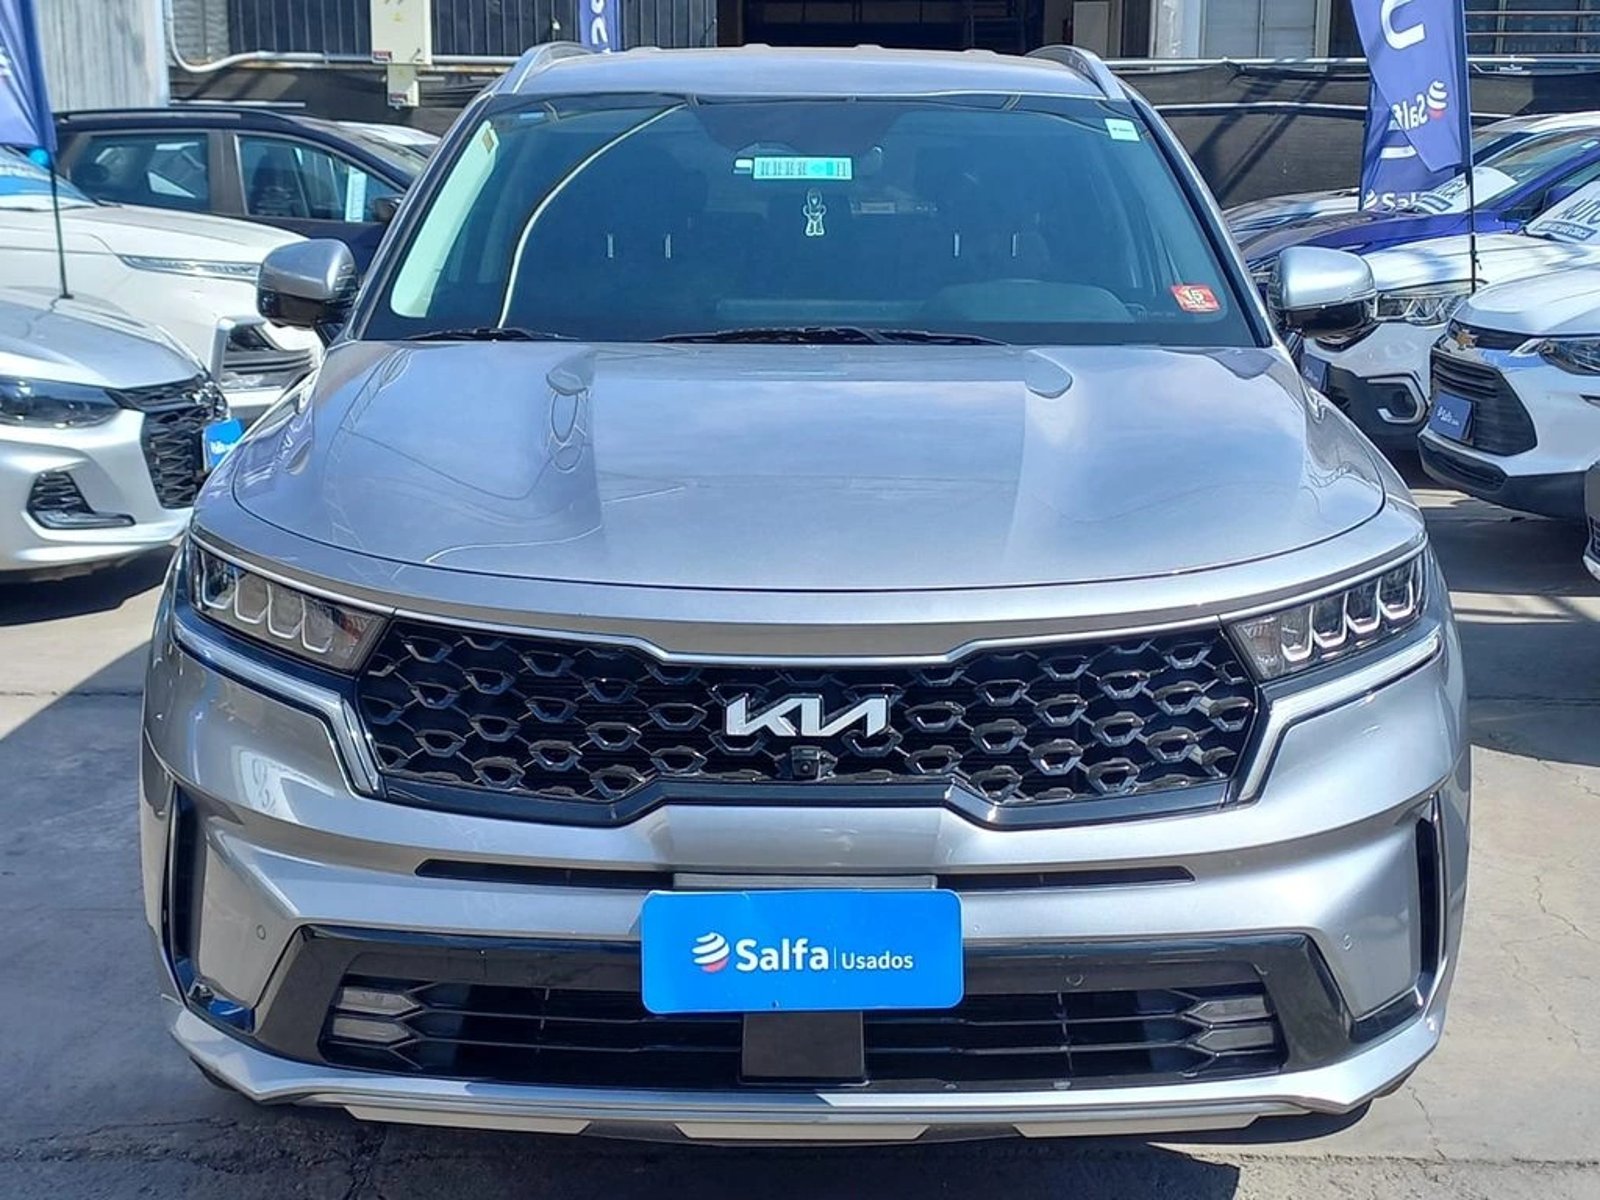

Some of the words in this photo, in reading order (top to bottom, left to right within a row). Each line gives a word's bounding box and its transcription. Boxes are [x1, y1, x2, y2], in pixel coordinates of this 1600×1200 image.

[726, 694, 888, 738] KIA
[735, 938, 829, 972] Salfa
[841, 950, 914, 970] Usados
